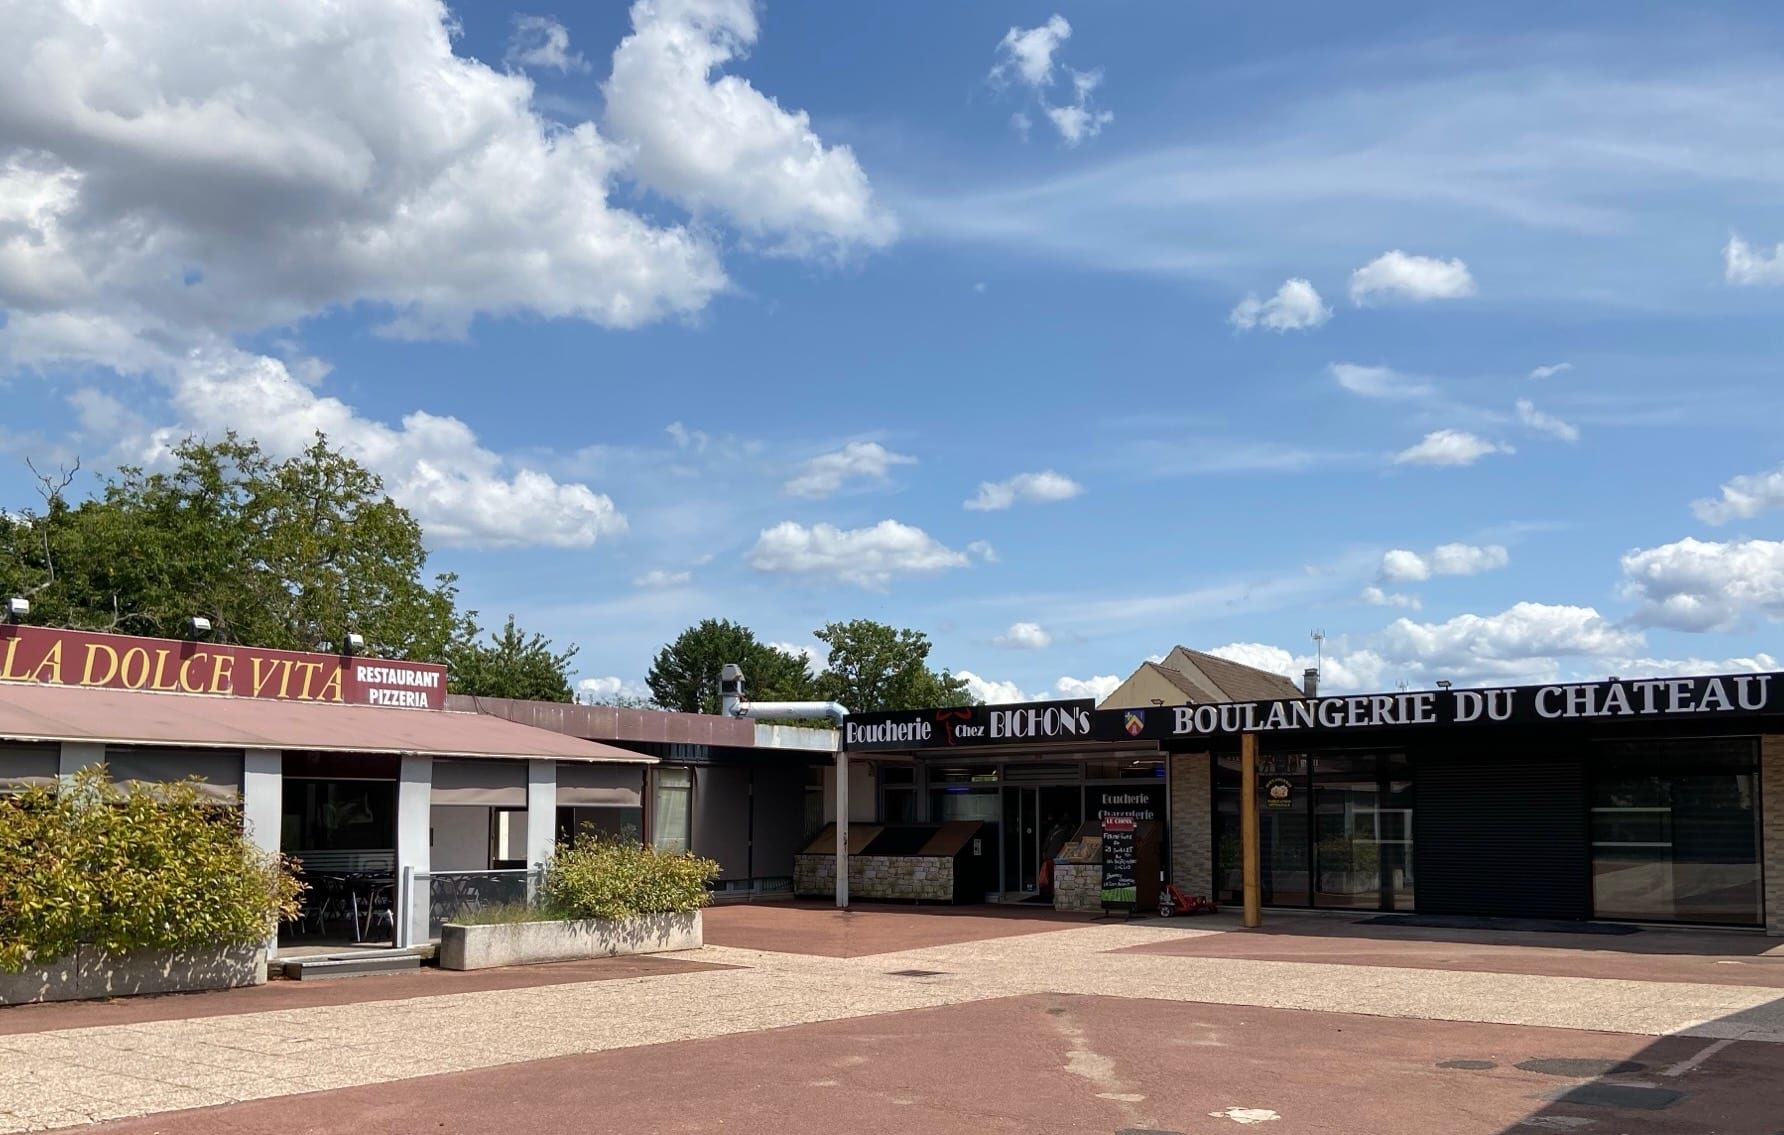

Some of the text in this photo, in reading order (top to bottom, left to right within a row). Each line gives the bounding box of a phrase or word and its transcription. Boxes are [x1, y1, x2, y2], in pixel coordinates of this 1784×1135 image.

[0, 636, 344, 702] LA DOLCE VITA
[357, 665, 440, 688] RESTAURANT
[369, 688, 429, 708] PIZZERIA
[1172, 692, 1436, 735] BOULANGERIE
[1452, 688, 1517, 722] DU
[846, 716, 932, 744] Boucherie
[955, 724, 985, 738] Chez
[1102, 793, 1149, 804] Boucherie
